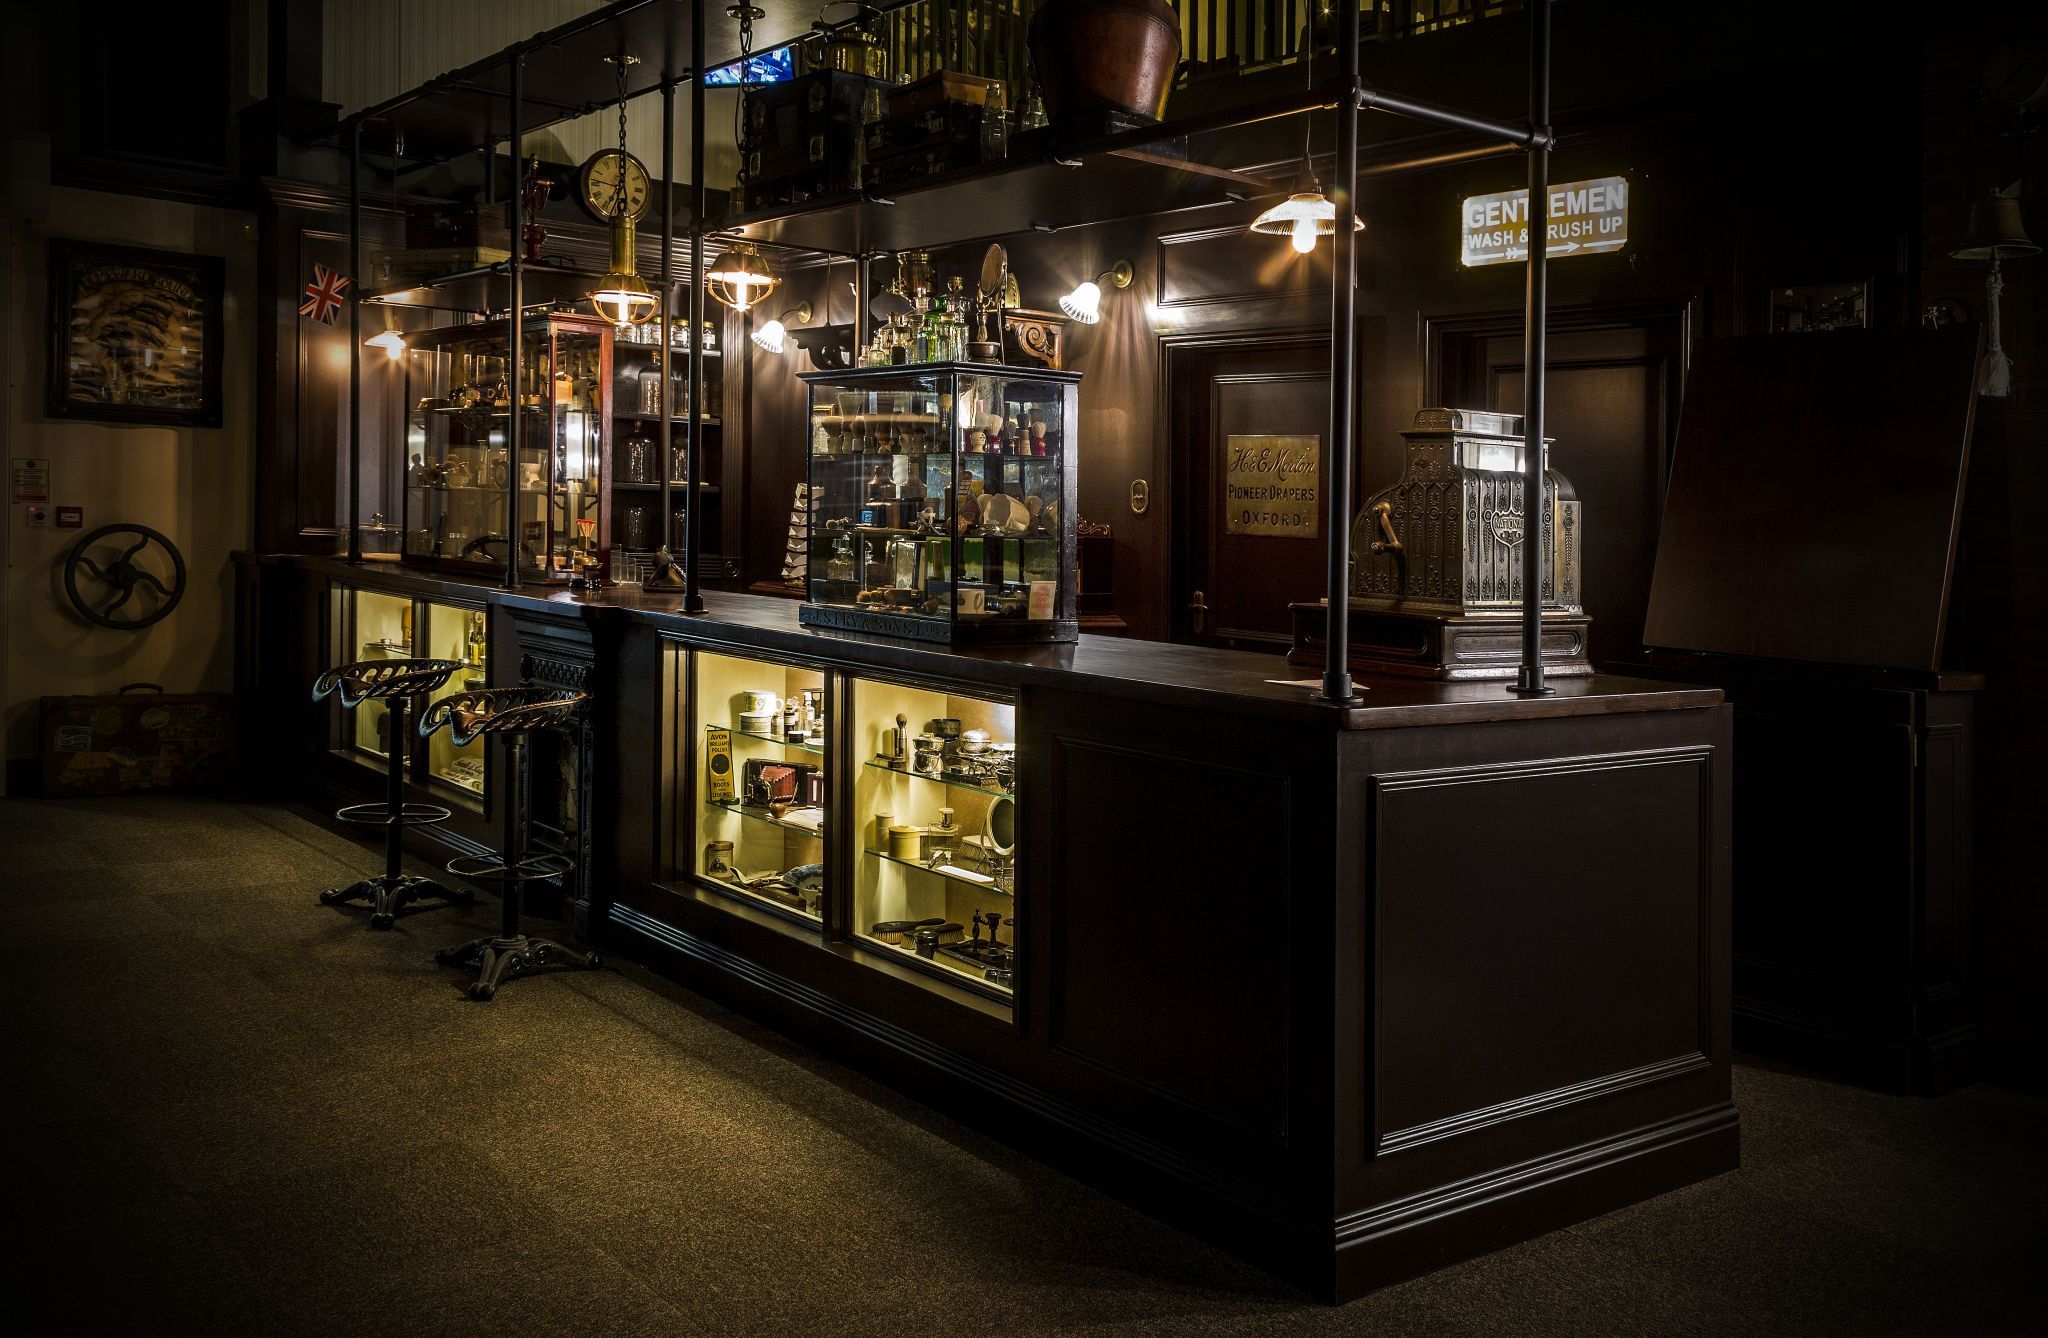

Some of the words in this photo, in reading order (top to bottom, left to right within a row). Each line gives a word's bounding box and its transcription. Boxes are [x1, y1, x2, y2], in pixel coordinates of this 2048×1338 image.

[1467, 183, 1625, 229] GENTEMEN
[1468, 229, 1514, 250] WASH
[1519, 228, 1529, 243] &
[1547, 219, 1593, 241] RUSH
[1600, 216, 1623, 234] UP
[1228, 484, 1268, 500] PIONEER
[1242, 510, 1301, 527] OXFORD
